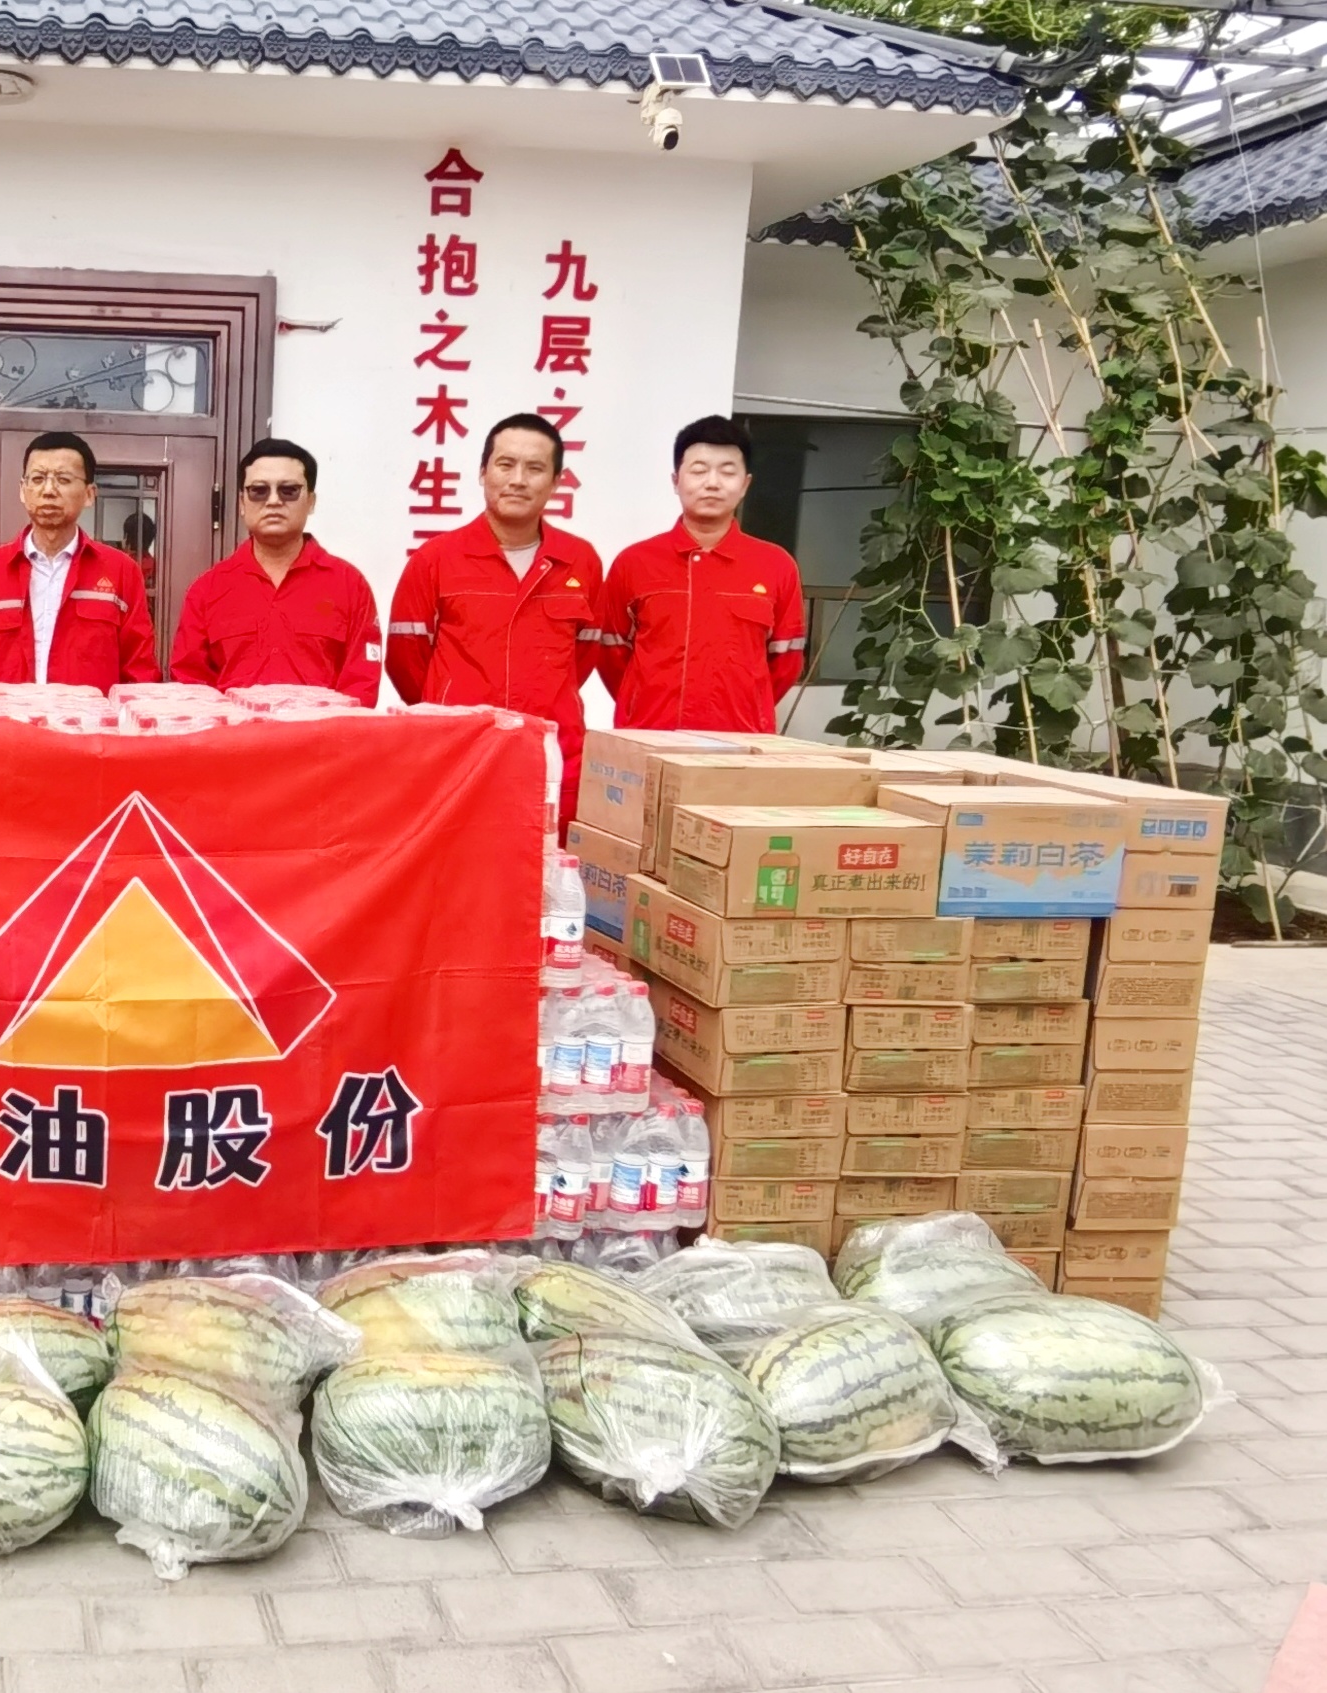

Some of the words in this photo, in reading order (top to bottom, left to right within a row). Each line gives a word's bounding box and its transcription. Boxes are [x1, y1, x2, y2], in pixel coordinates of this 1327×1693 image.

[406, 147, 484, 557] 合抱之木生
[841, 847, 895, 866] 好自在
[963, 841, 1105, 868] 茉莉白茶
[580, 862, 627, 898] 莉白茶
